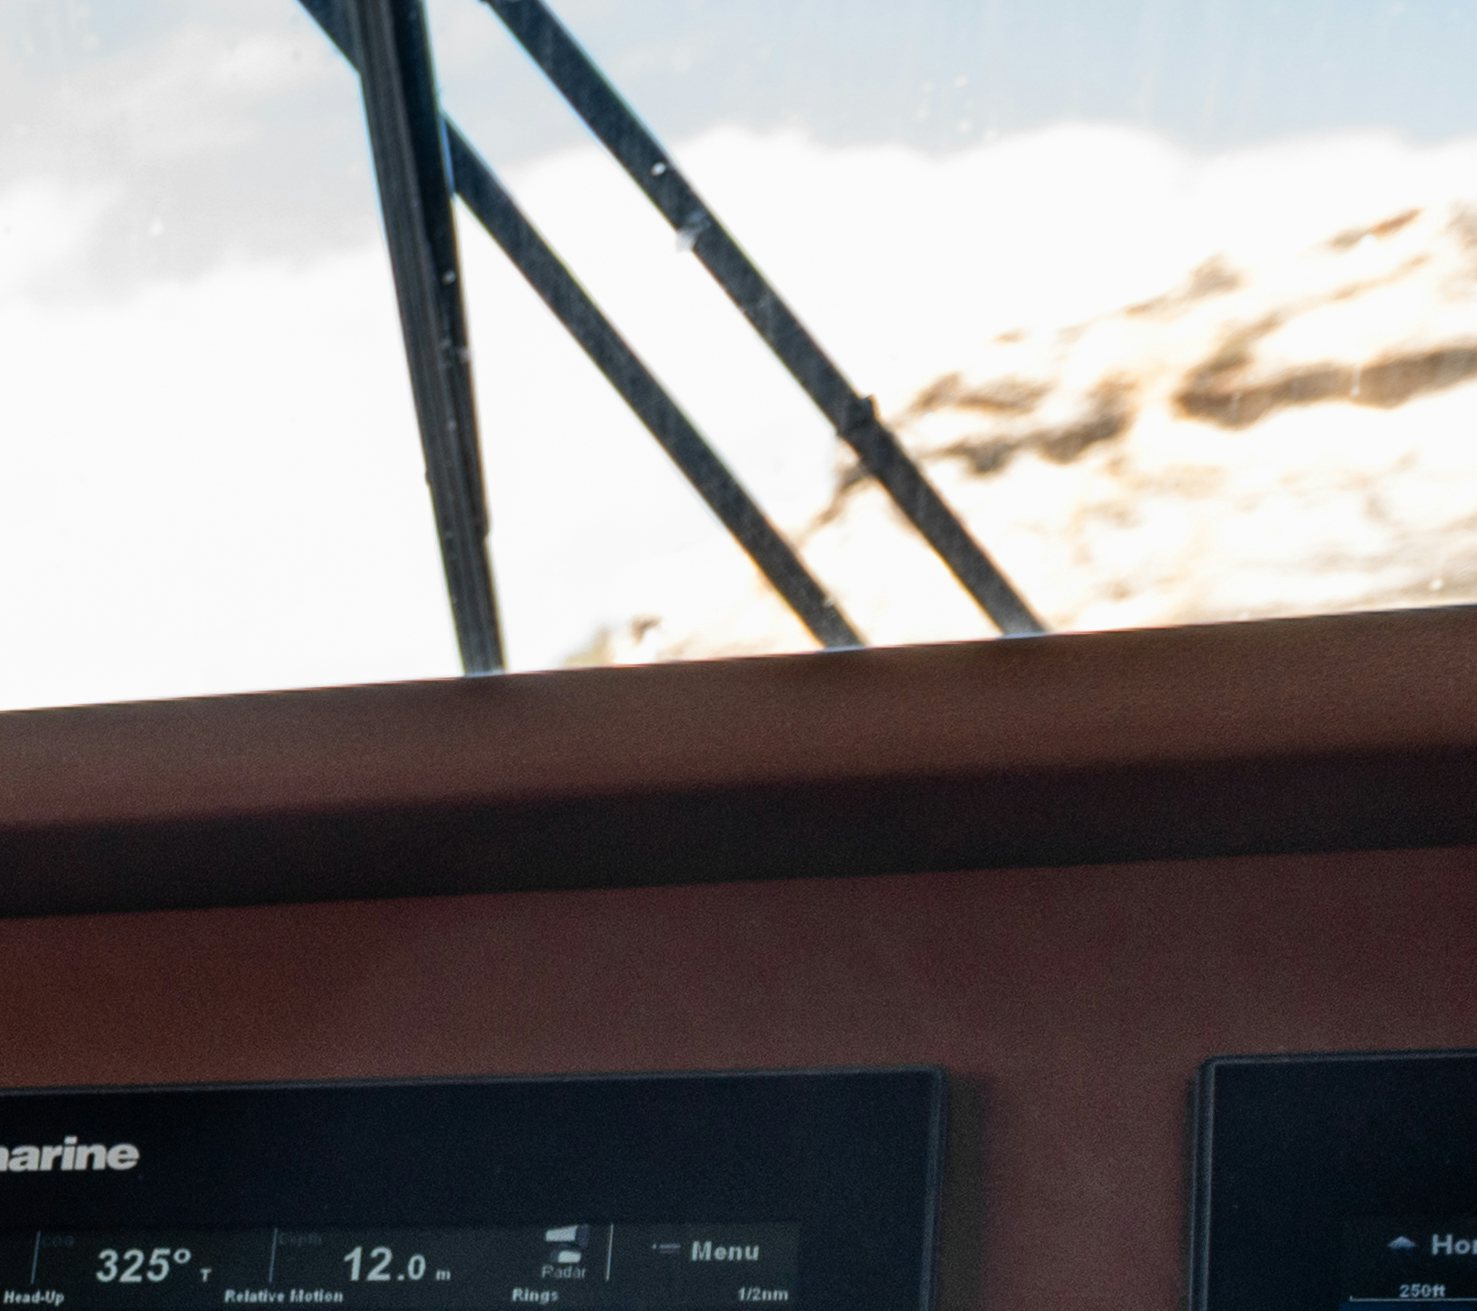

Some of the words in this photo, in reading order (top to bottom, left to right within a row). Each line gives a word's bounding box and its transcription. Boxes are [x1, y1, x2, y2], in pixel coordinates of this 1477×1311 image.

[691, 1241, 759, 1261] Menu
[96, 1247, 192, 1283] 325°
[343, 1245, 427, 1282] 12.0
[436, 1269, 451, 1281] m
[3, 1289, 65, 1306] Head-Up
[224, 1288, 285, 1303] Relative
[290, 1288, 343, 1303] Motion
[511, 1287, 559, 1305] Rings
[1399, 1284, 1446, 1298] 250ft
